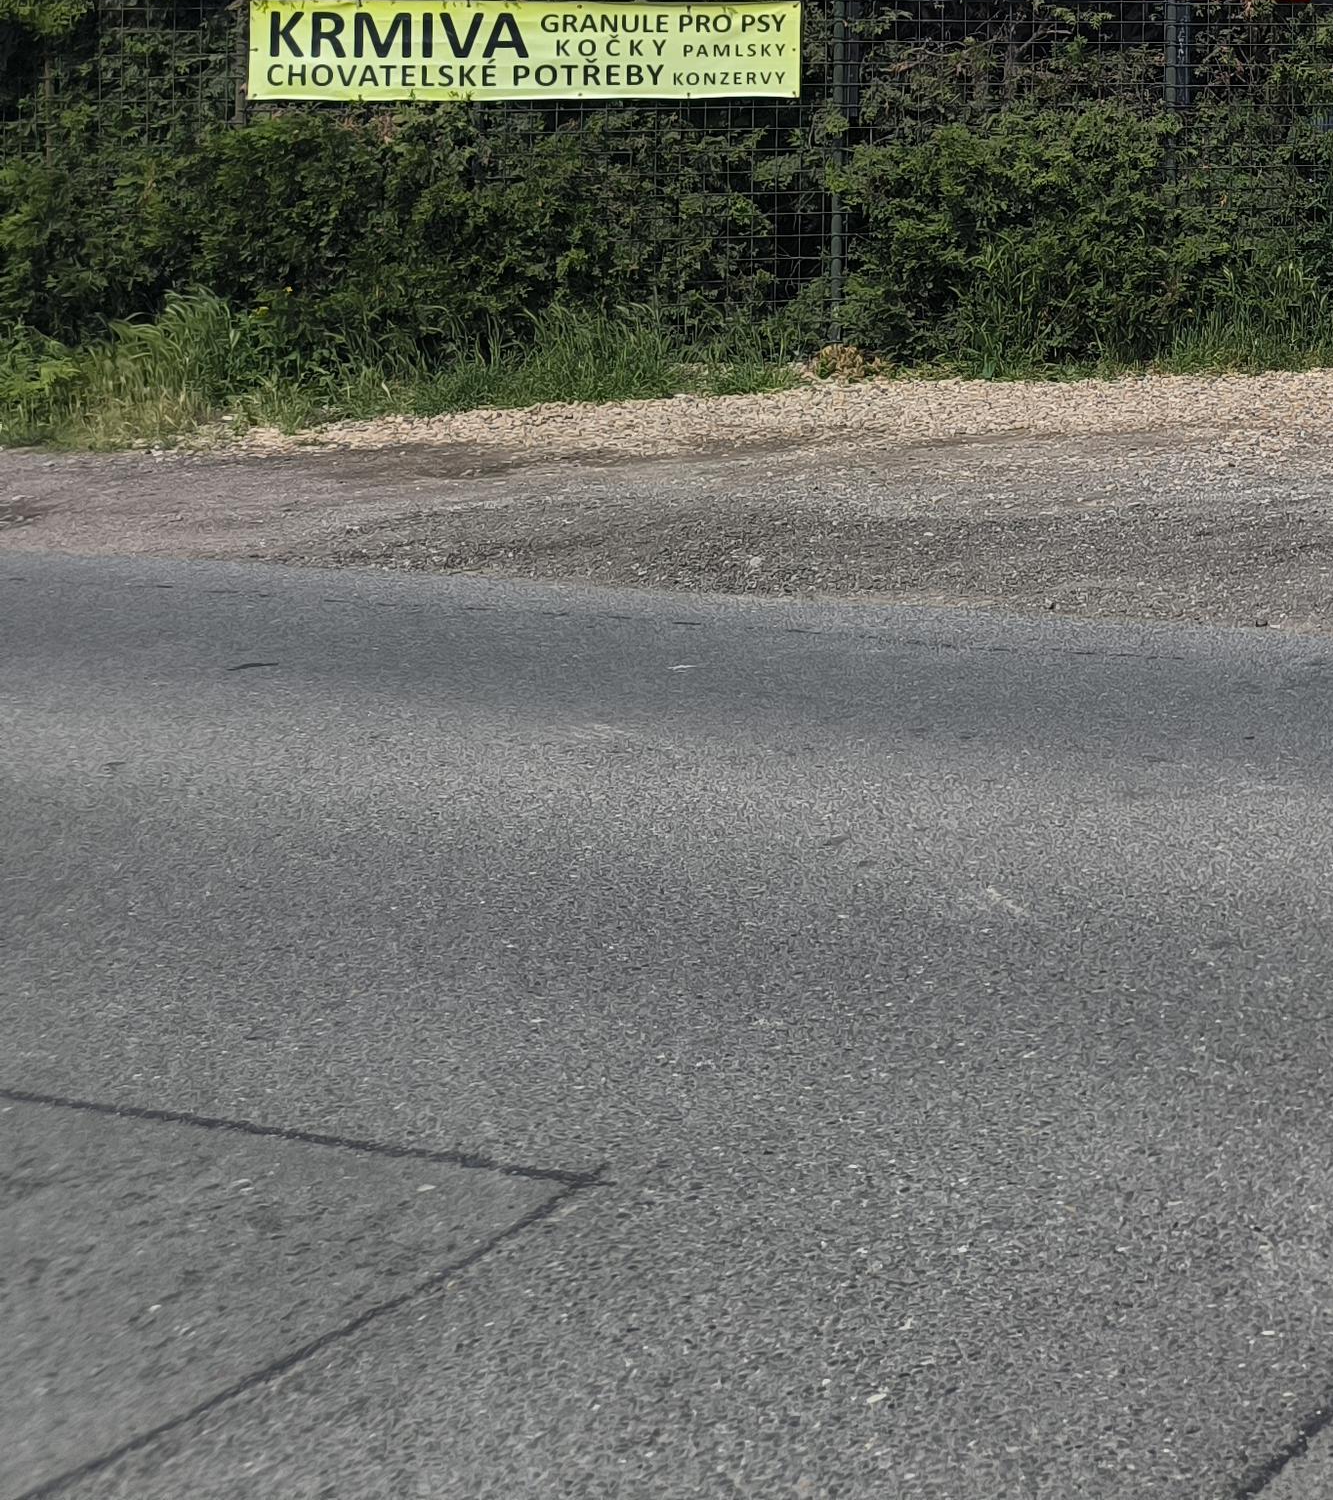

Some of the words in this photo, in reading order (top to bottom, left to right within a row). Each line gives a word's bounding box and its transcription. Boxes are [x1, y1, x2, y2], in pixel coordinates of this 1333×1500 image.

[270, 11, 529, 58] KRMIVA
[540, 14, 669, 33] GRANULE
[679, 14, 732, 33] PRO
[741, 14, 787, 33] PSY
[556, 34, 667, 57] KOČKY
[683, 43, 786, 57] PAMLSKY
[267, 58, 497, 87] CHOVATELSKÉ
[513, 58, 664, 87] POTŘEBY
[673, 71, 786, 85] KONZERVY
